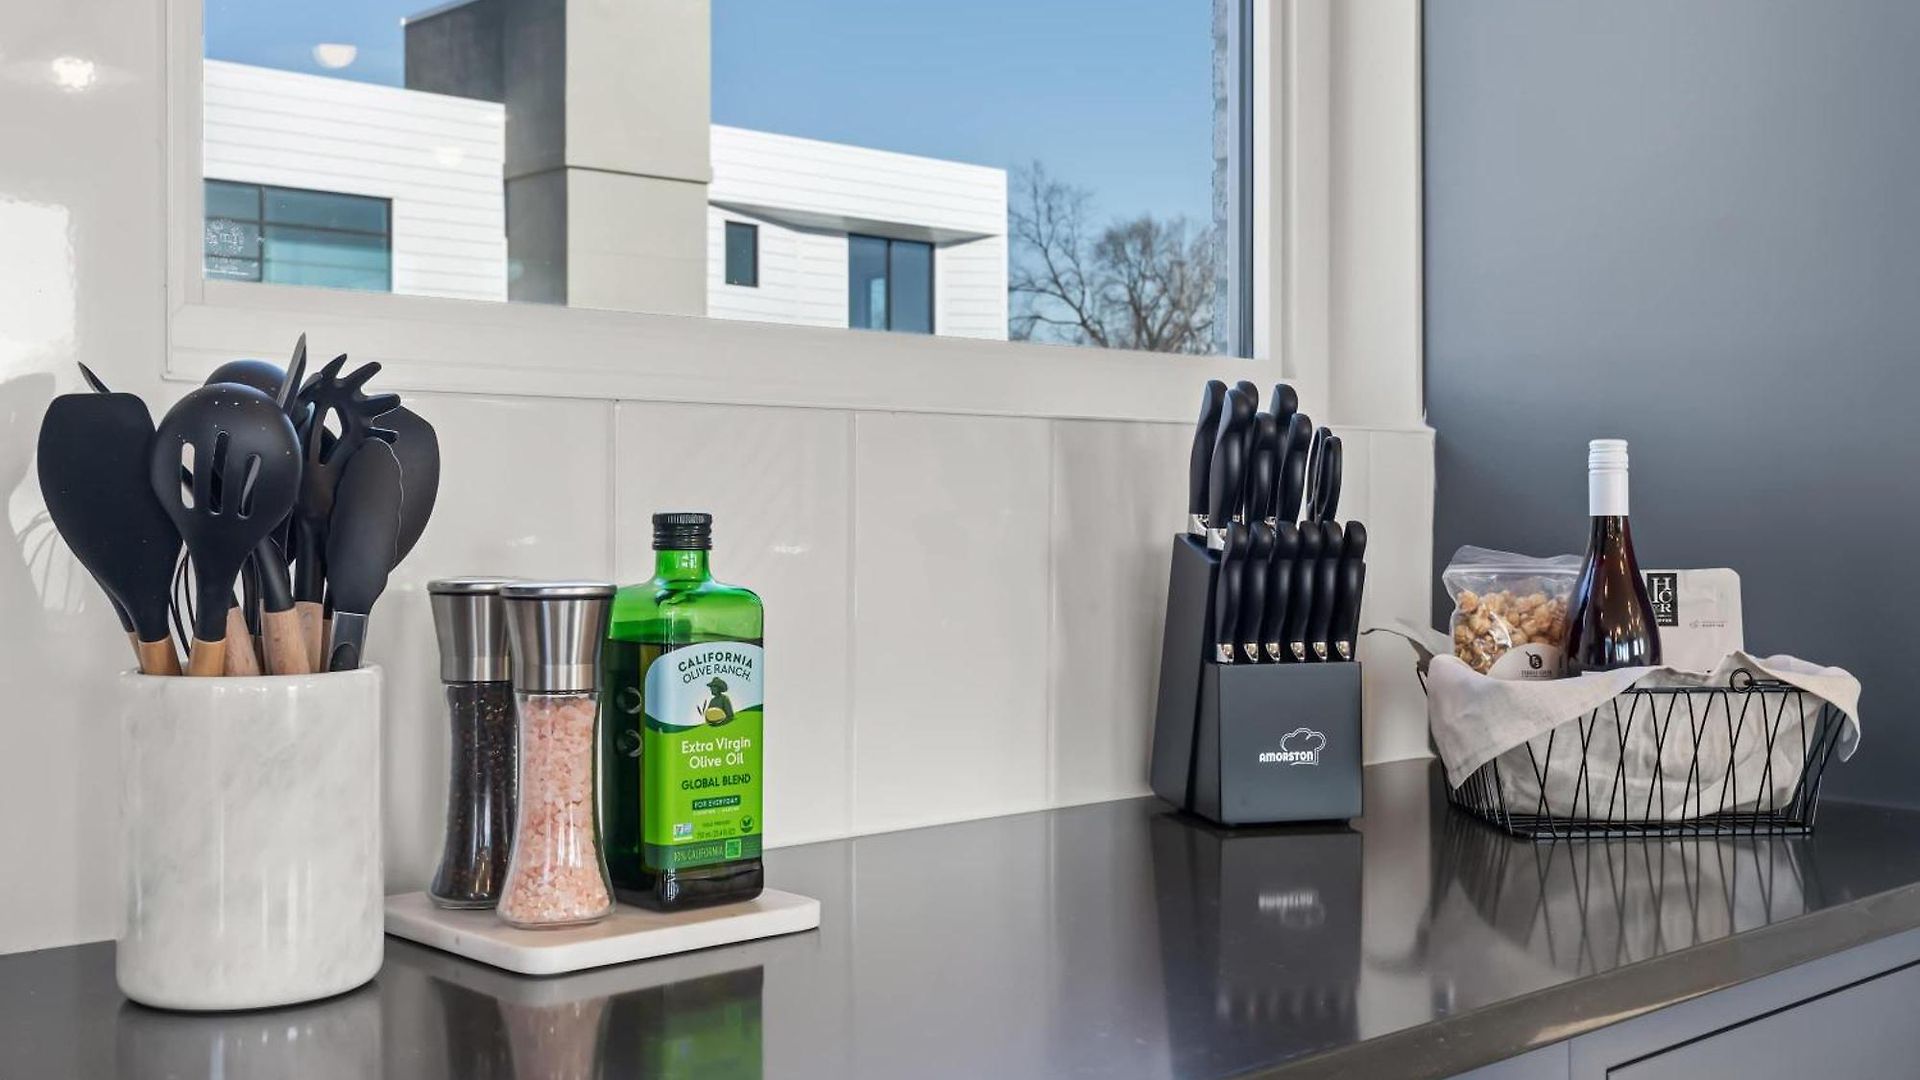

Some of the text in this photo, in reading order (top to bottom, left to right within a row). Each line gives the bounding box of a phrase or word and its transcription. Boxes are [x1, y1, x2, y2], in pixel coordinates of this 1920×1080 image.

[678, 652, 753, 672] CALIFORNIA
[682, 665, 712, 684] OLIVE
[681, 737, 751, 754] Extra Virgin
[689, 752, 744, 769] Olive Oil
[681, 773, 751, 790] GLOBAL BLEND
[694, 796, 739, 809] FOR EVERYDAY
